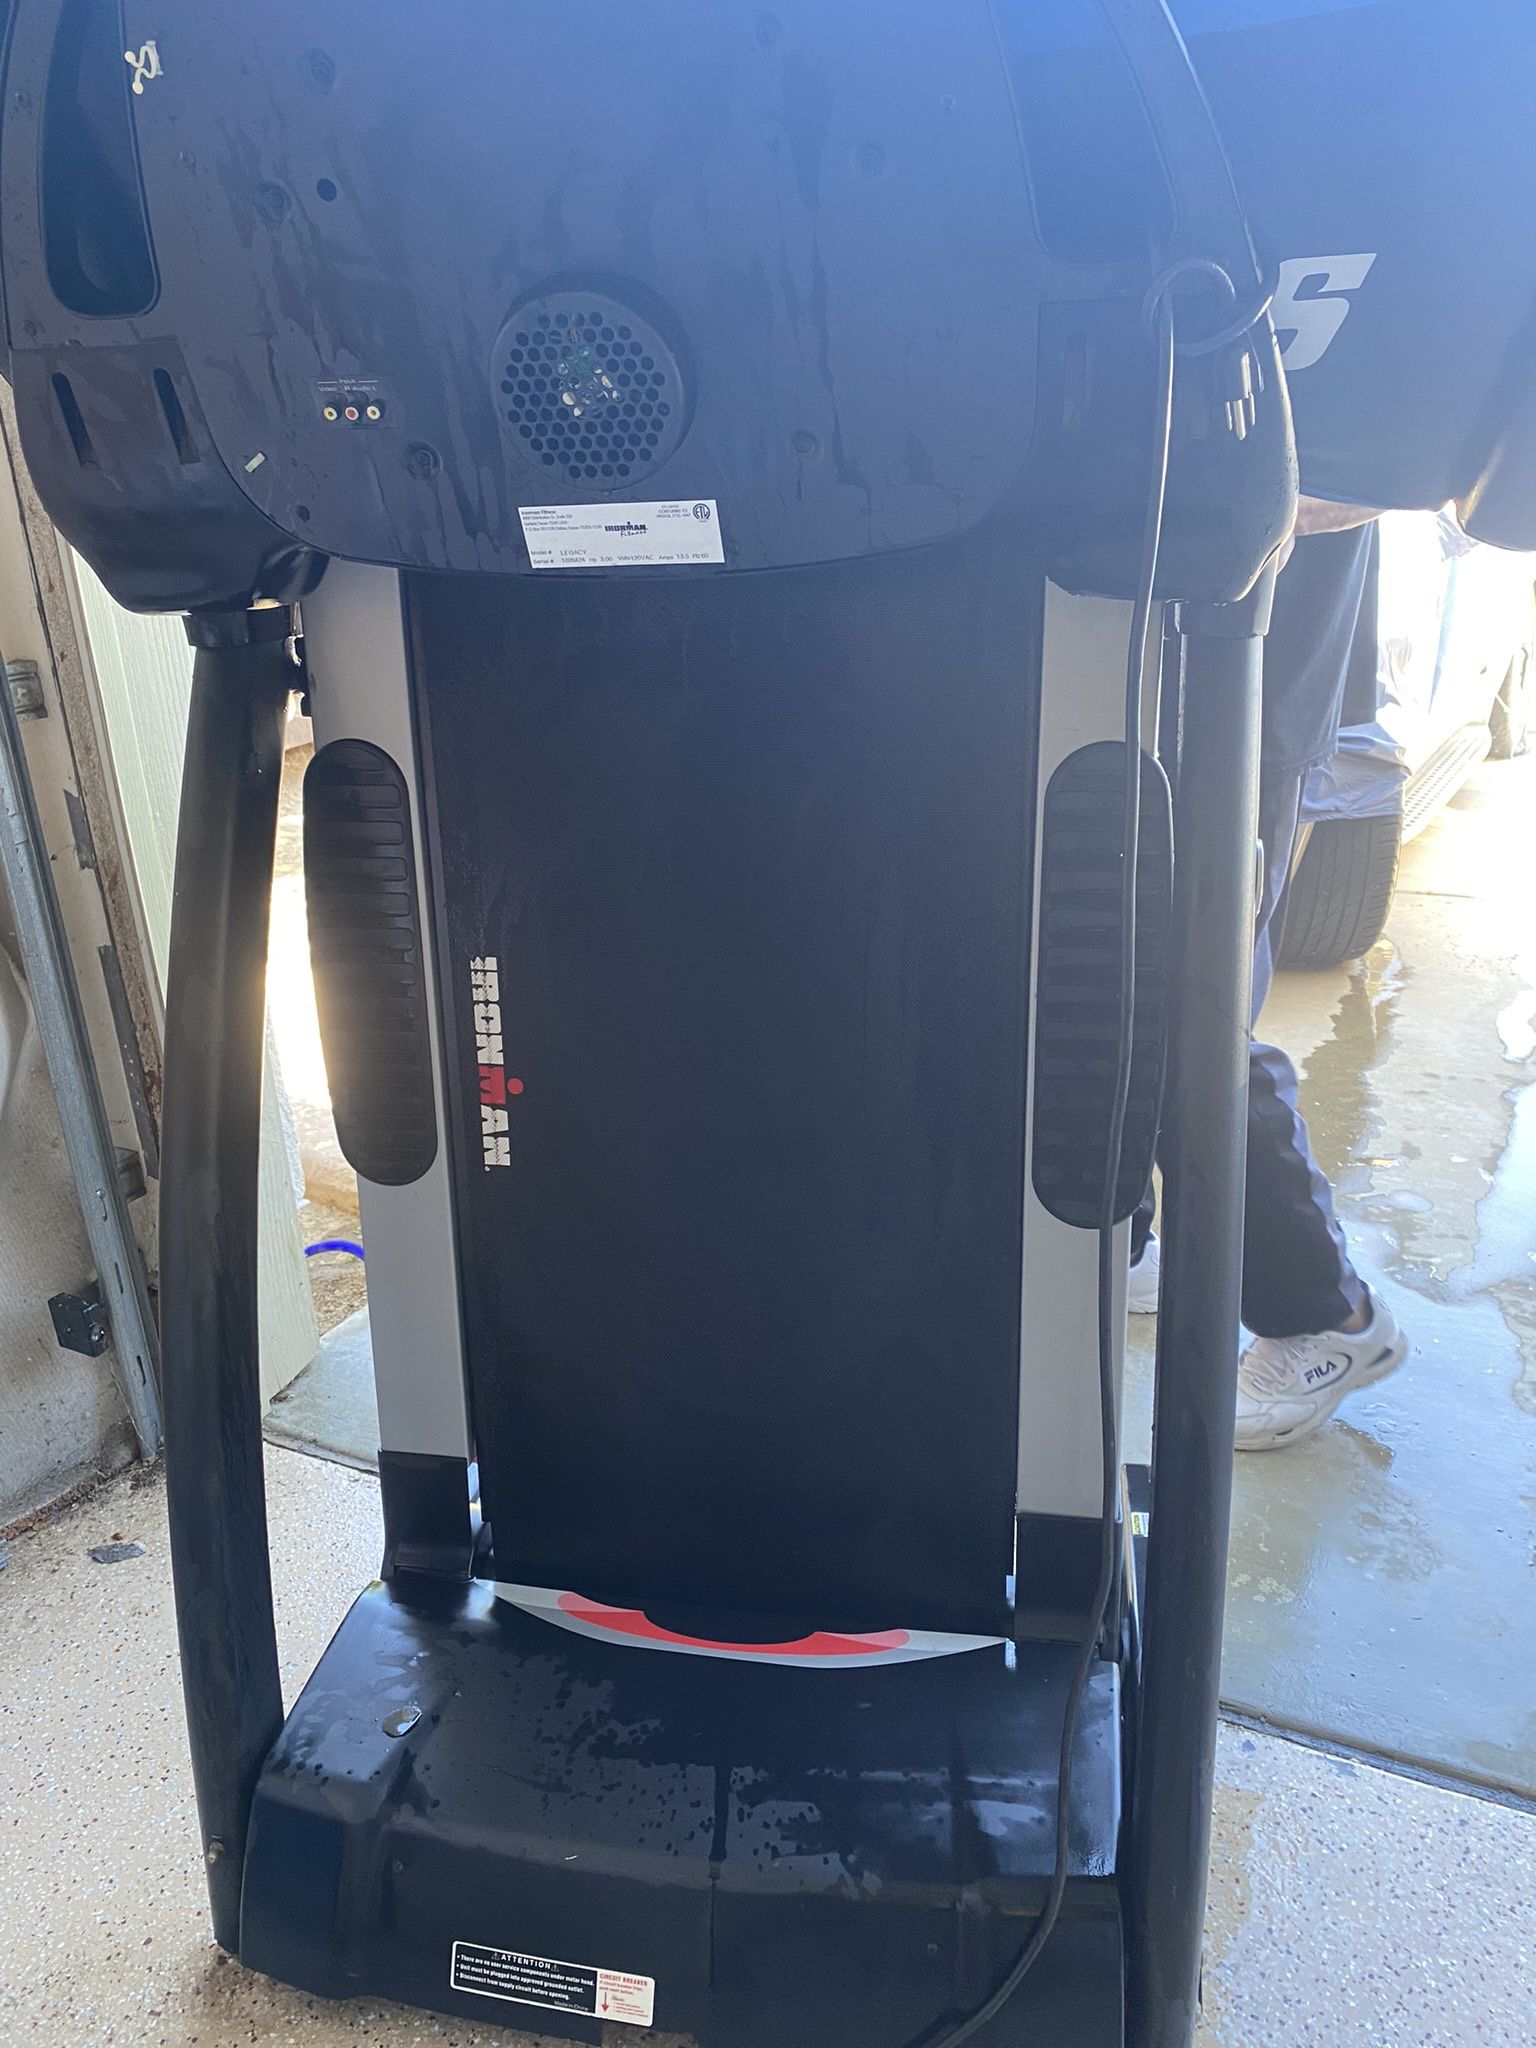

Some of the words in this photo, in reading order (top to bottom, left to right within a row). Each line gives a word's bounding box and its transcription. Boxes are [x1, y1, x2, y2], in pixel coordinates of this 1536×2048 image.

[605, 521, 648, 531] IRONMAN
[470, 956, 524, 1166] IRONMAN
[1304, 1360, 1338, 1384] FILA
[461, 1954, 474, 1962] There
[502, 1964, 519, 1972] service
[520, 1967, 549, 1978] components
[550, 1973, 565, 1981] under
[501, 1954, 550, 1969] ATTENTION
[460, 1972, 486, 1983] Disconnect
[499, 1981, 515, 1990] supply
[532, 1987, 548, 1996] before
[490, 1970, 510, 1979] plugged
[520, 1976, 543, 1986] approved
[544, 1981, 567, 1990] grounded
[600, 1973, 621, 1982] CIRCUIT
[622, 1977, 648, 1986] BREAKER
